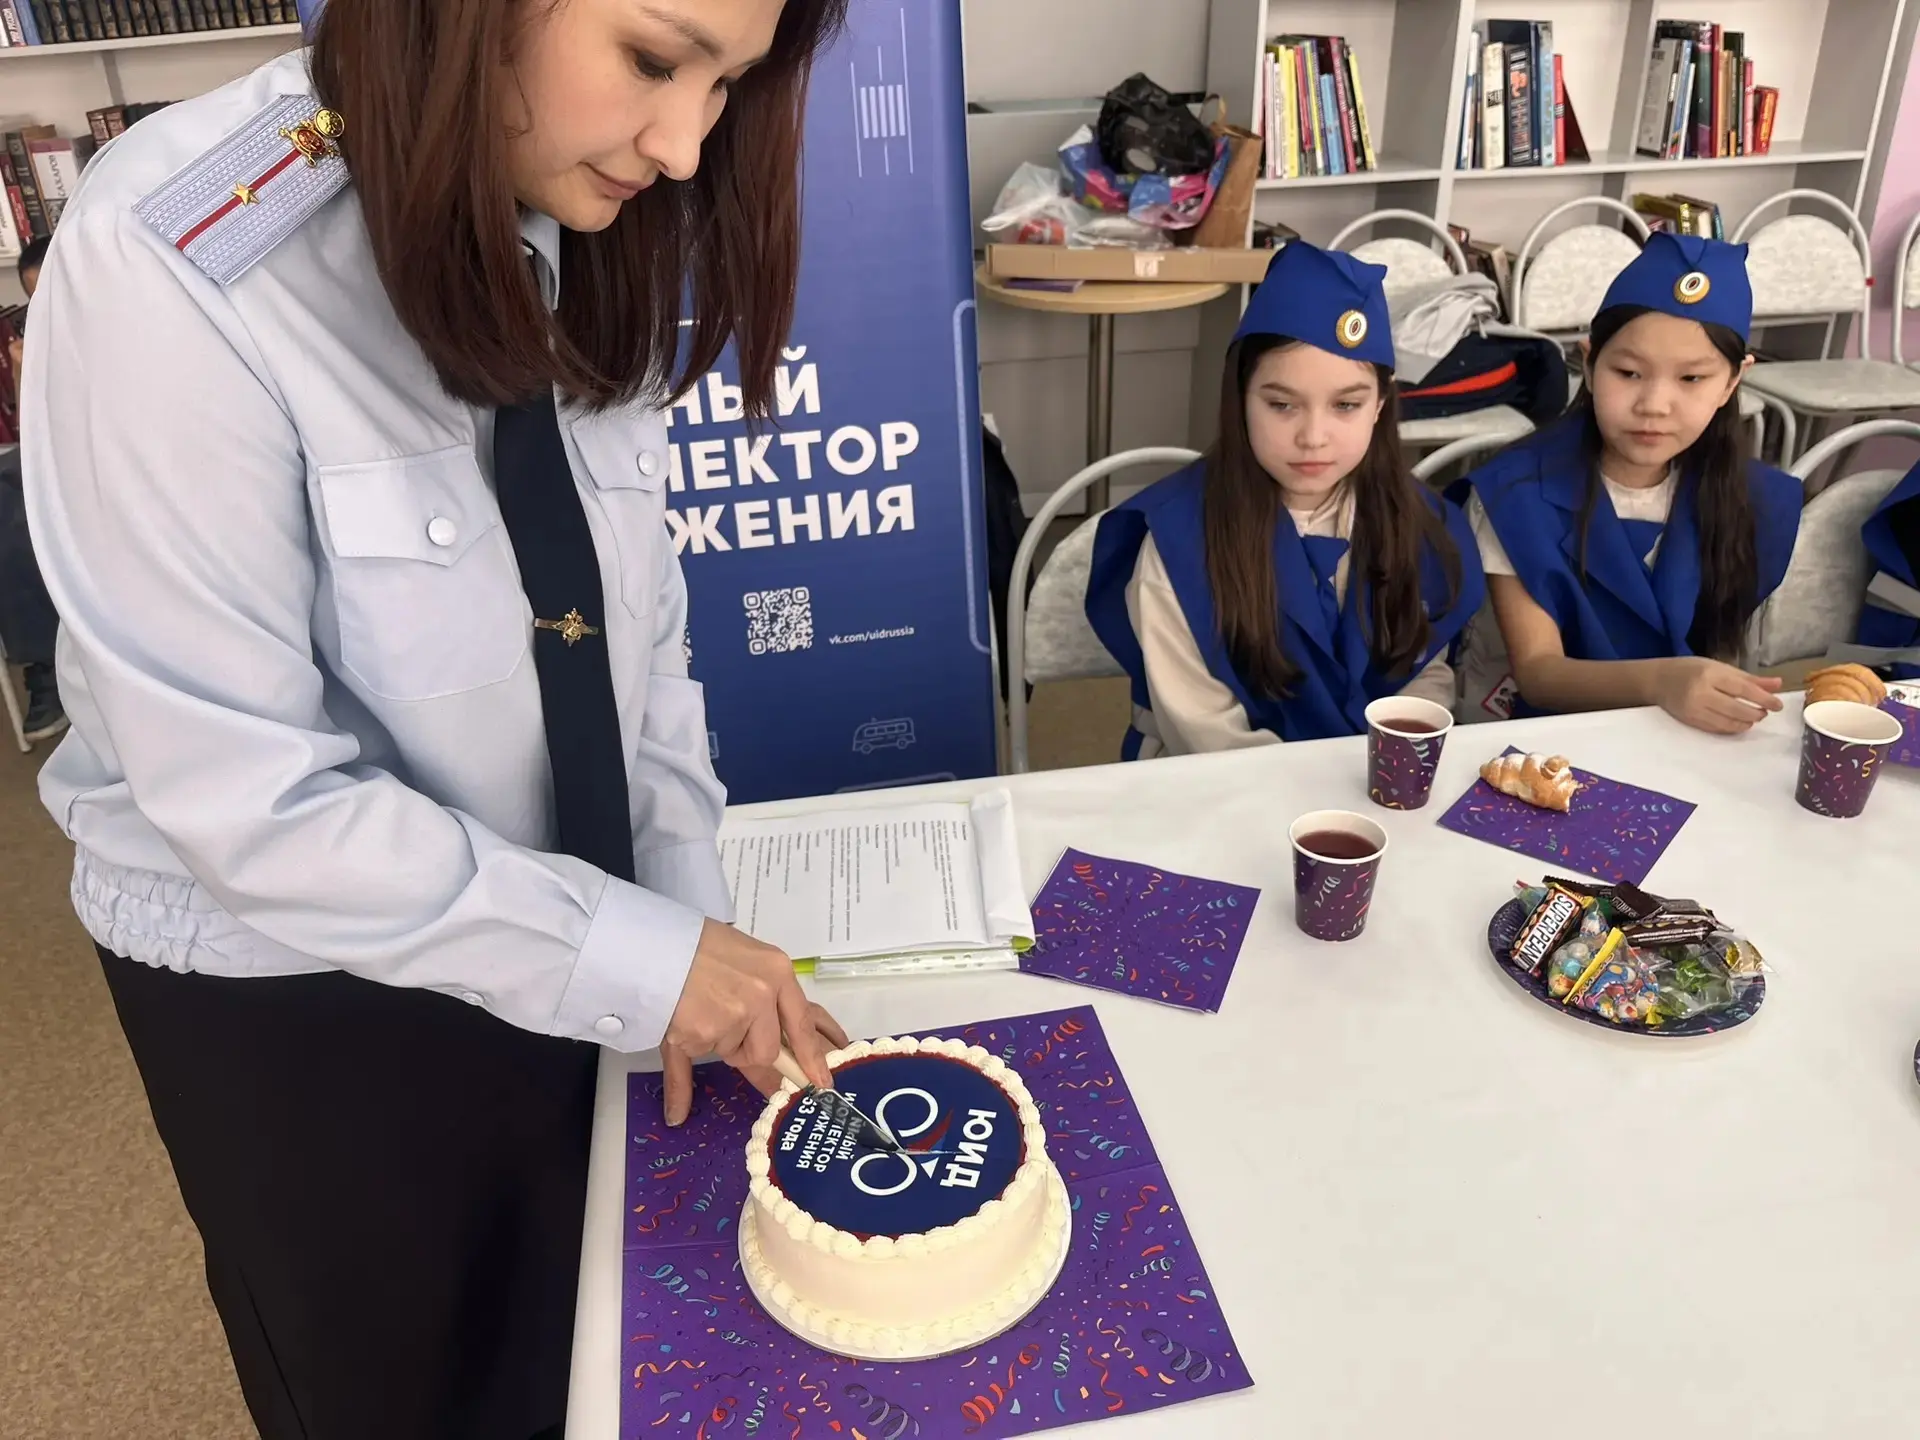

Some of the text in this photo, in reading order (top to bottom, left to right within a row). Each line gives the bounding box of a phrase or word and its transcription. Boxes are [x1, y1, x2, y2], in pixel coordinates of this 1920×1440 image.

[665, 345, 821, 428] НЫЙ
[664, 484, 915, 556] ЖЕНИЯ
[829, 625, 915, 645] vk.com/uidrussia
[780, 1117, 807, 1151] года
[796, 1110, 831, 1169] ИЖЕНИЯ
[940, 1108, 997, 1188] ЮИД
